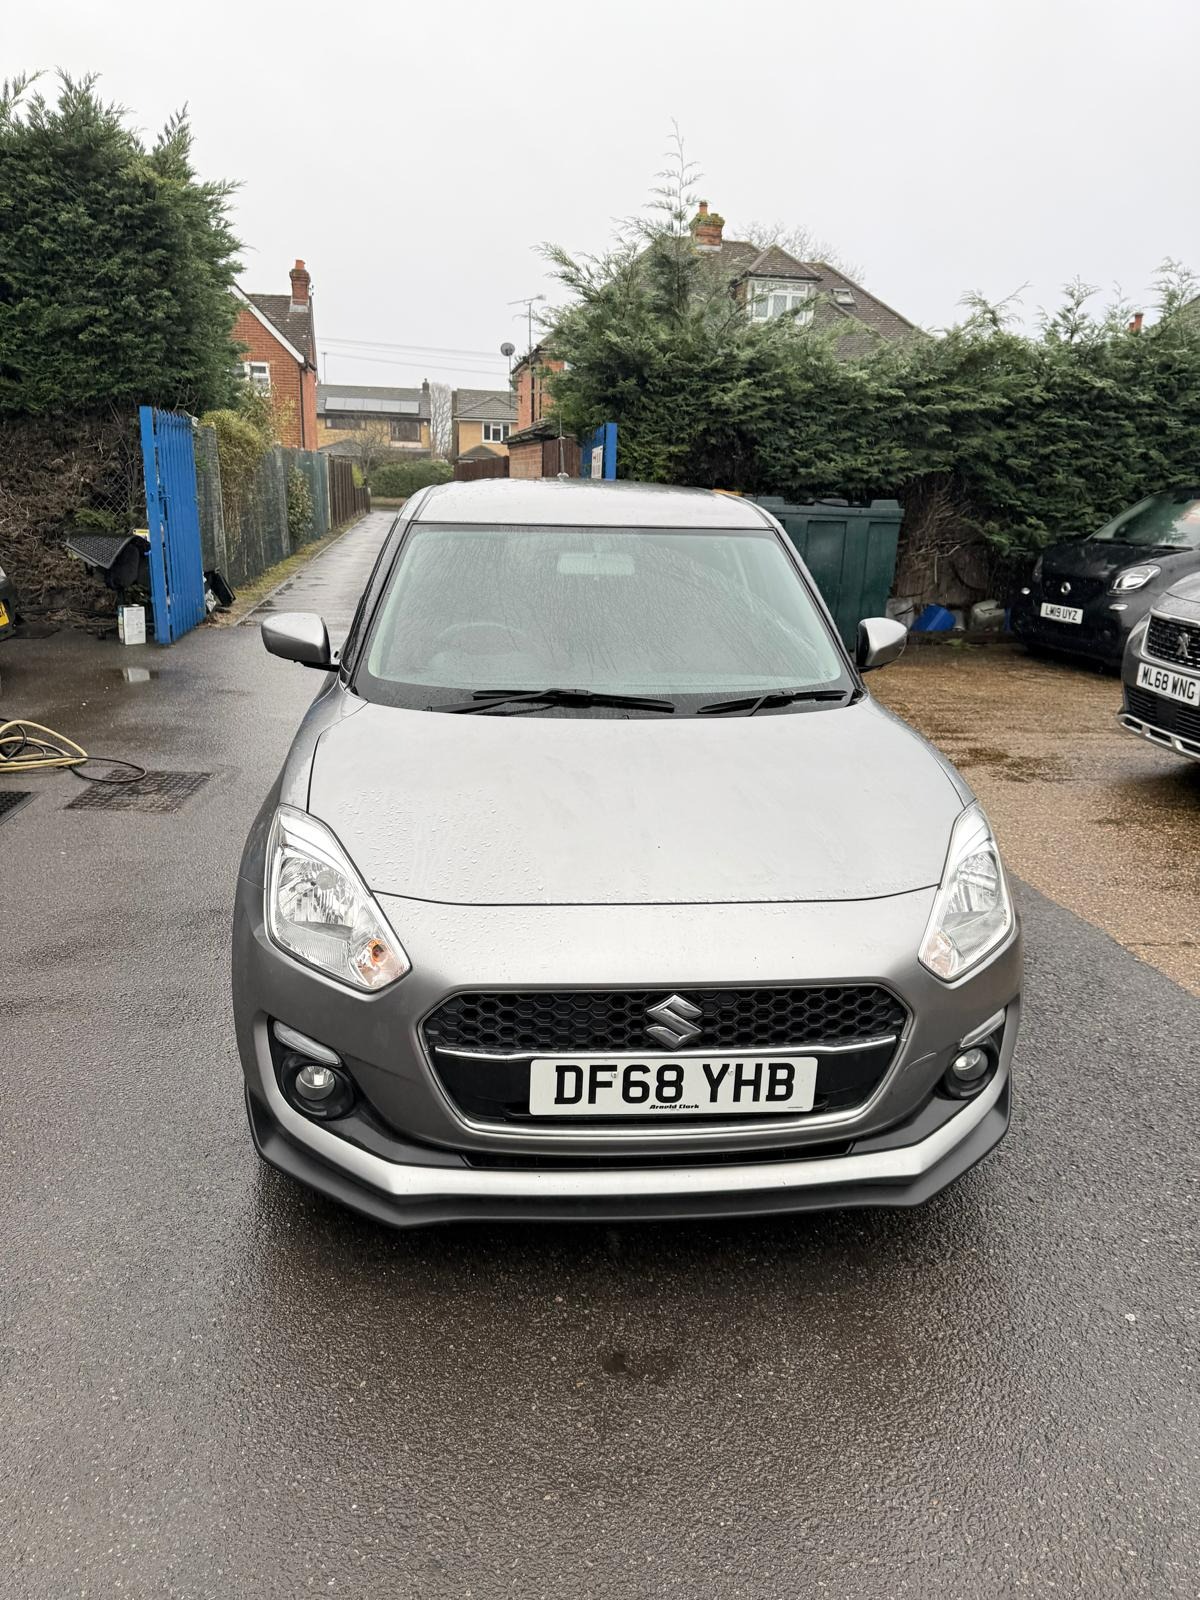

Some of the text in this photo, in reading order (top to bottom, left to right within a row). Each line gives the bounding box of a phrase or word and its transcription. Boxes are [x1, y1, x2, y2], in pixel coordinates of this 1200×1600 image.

[1062, 607, 1078, 621] UYZ
[1141, 666, 1197, 700] ML68 WNG
[554, 1063, 796, 1104] DF68 YHB
